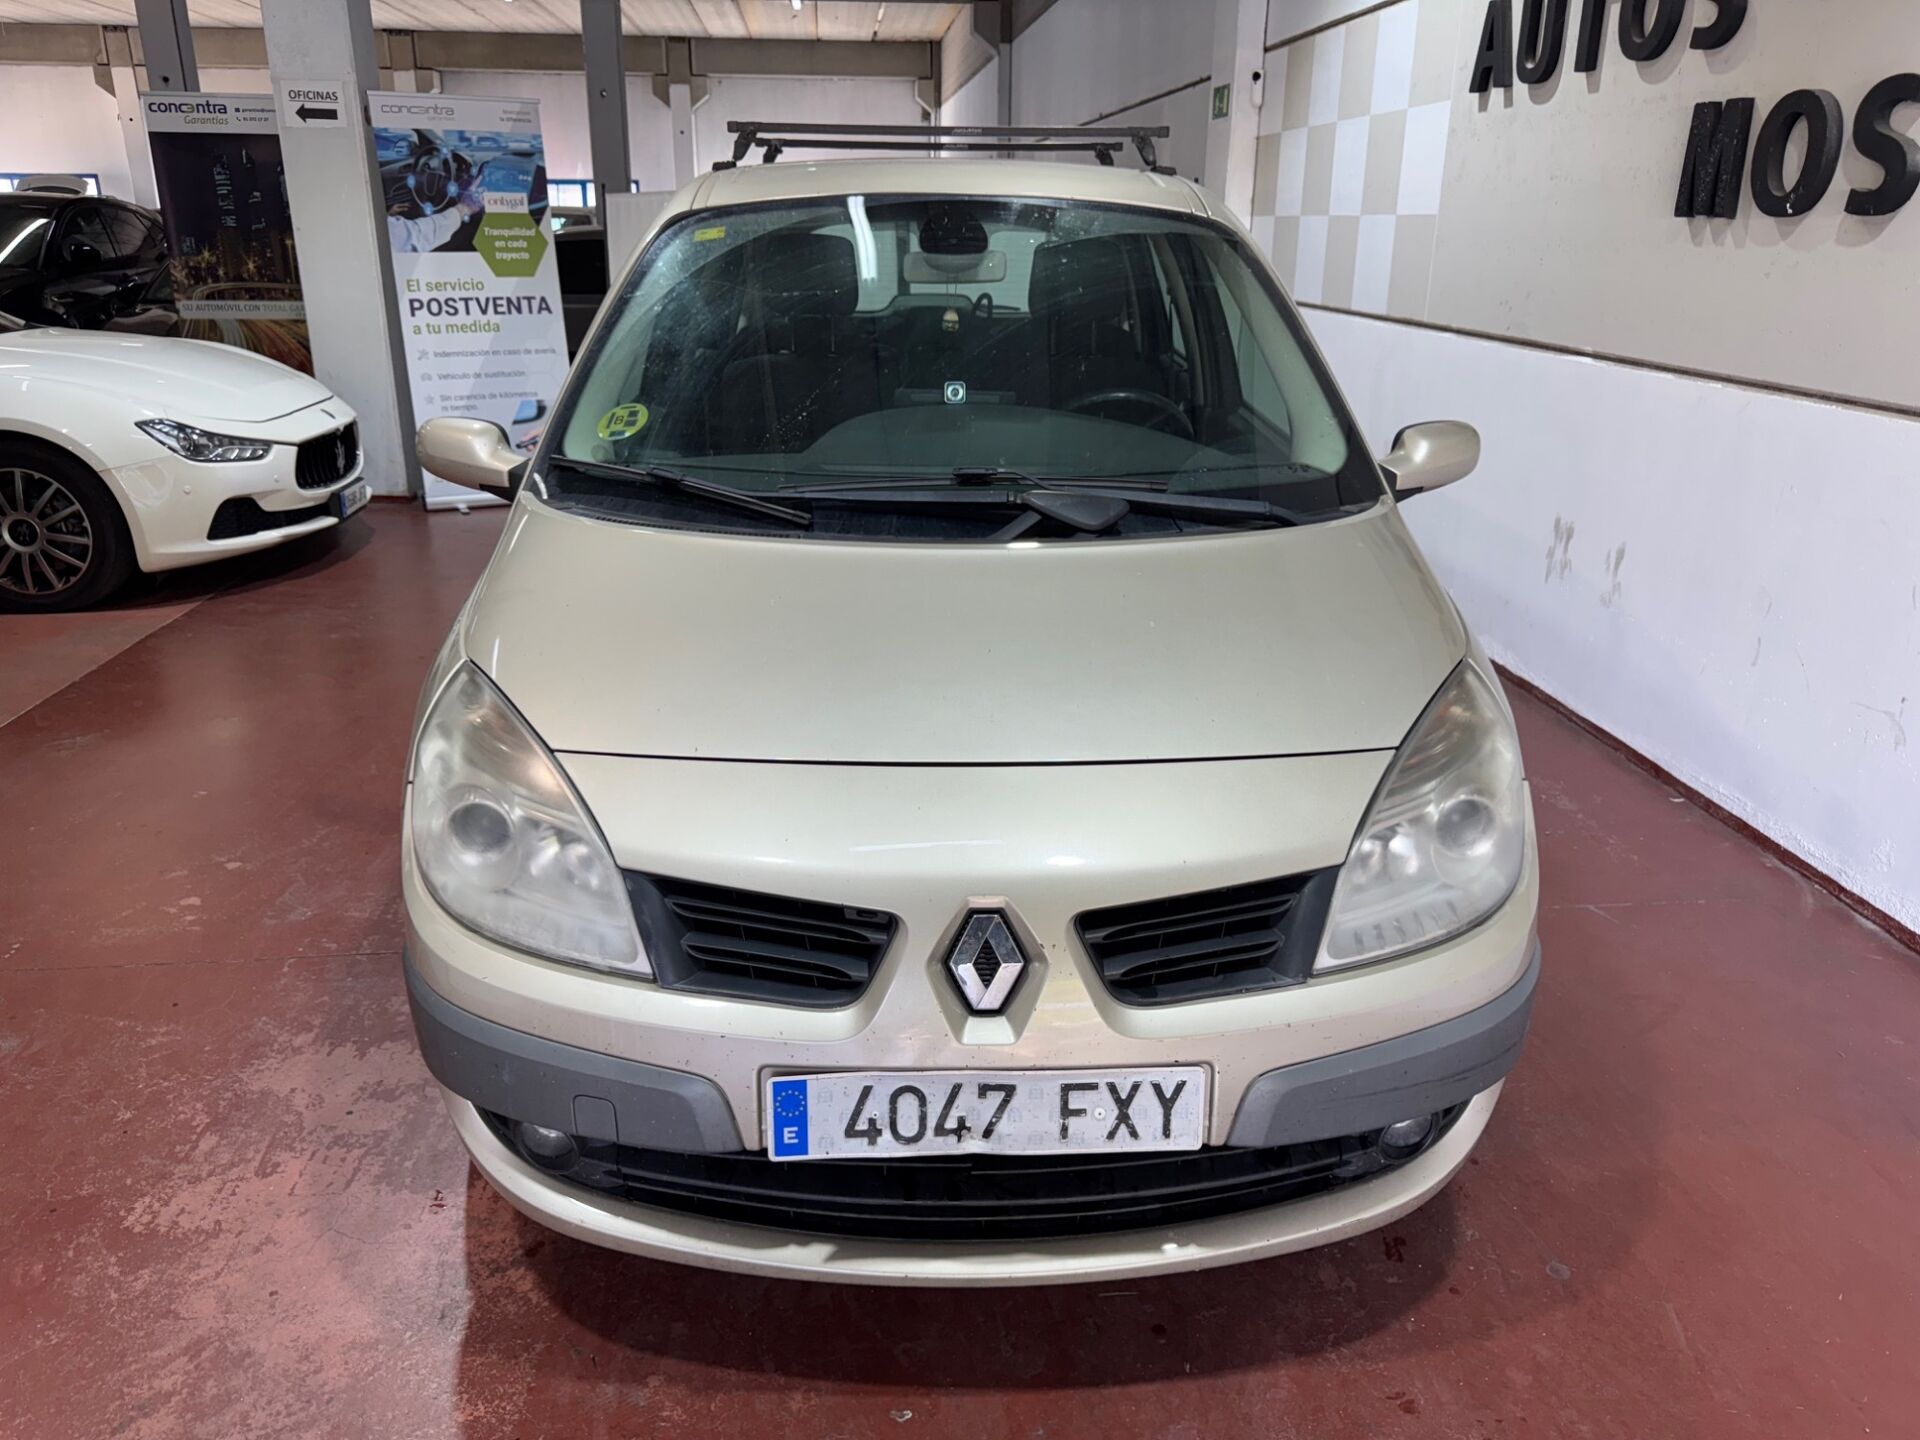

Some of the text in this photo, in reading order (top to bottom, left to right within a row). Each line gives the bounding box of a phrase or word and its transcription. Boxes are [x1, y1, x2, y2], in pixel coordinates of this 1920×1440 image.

[288, 89, 338, 101] OFICINAS
[148, 100, 228, 114] concentra
[381, 104, 455, 116] concentra
[1674, 73, 1920, 219] MOS
[483, 227, 536, 238] Tranquilidad
[494, 239, 528, 248] en cada
[495, 252, 530, 262] trayecto
[406, 278, 485, 292] El servicio
[182, 304, 193, 312] SU
[195, 303, 243, 312] AUTOMÓVIL
[244, 303, 261, 312] CON
[408, 296, 553, 317] POSTVENTA
[413, 319, 500, 335] a tu medida
[613, 415, 624, 425] B
[783, 1079, 1187, 1146] E 4047 FXY
